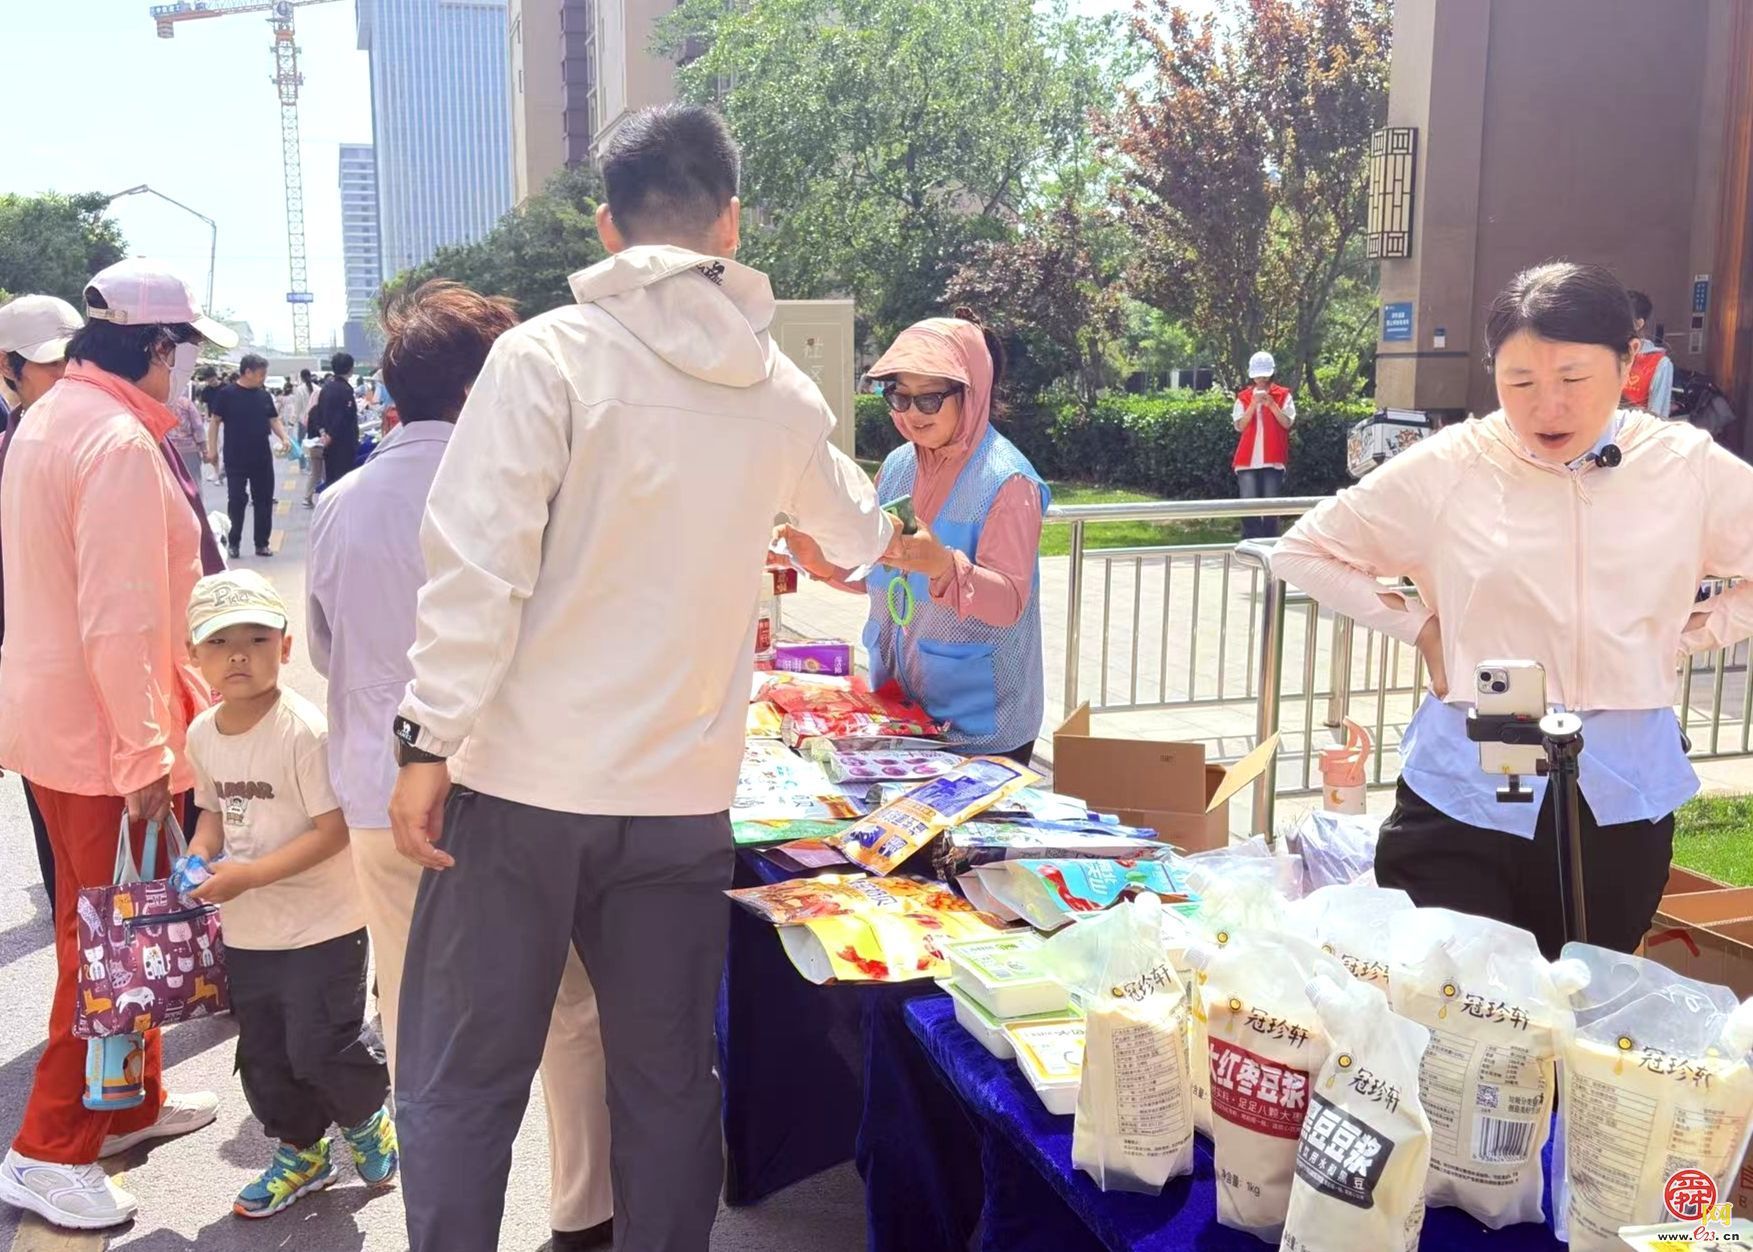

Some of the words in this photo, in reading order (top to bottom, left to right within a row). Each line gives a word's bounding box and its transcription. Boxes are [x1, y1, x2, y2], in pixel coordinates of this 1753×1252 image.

[1124, 963, 1172, 1002] 冠珍轩
[1244, 1007, 1309, 1049] 冠珍轩
[1461, 993, 1530, 1031] 冠珍轩
[1638, 1046, 1713, 1089] 冠珍轩
[1347, 1066, 1401, 1114] 冠珍轩
